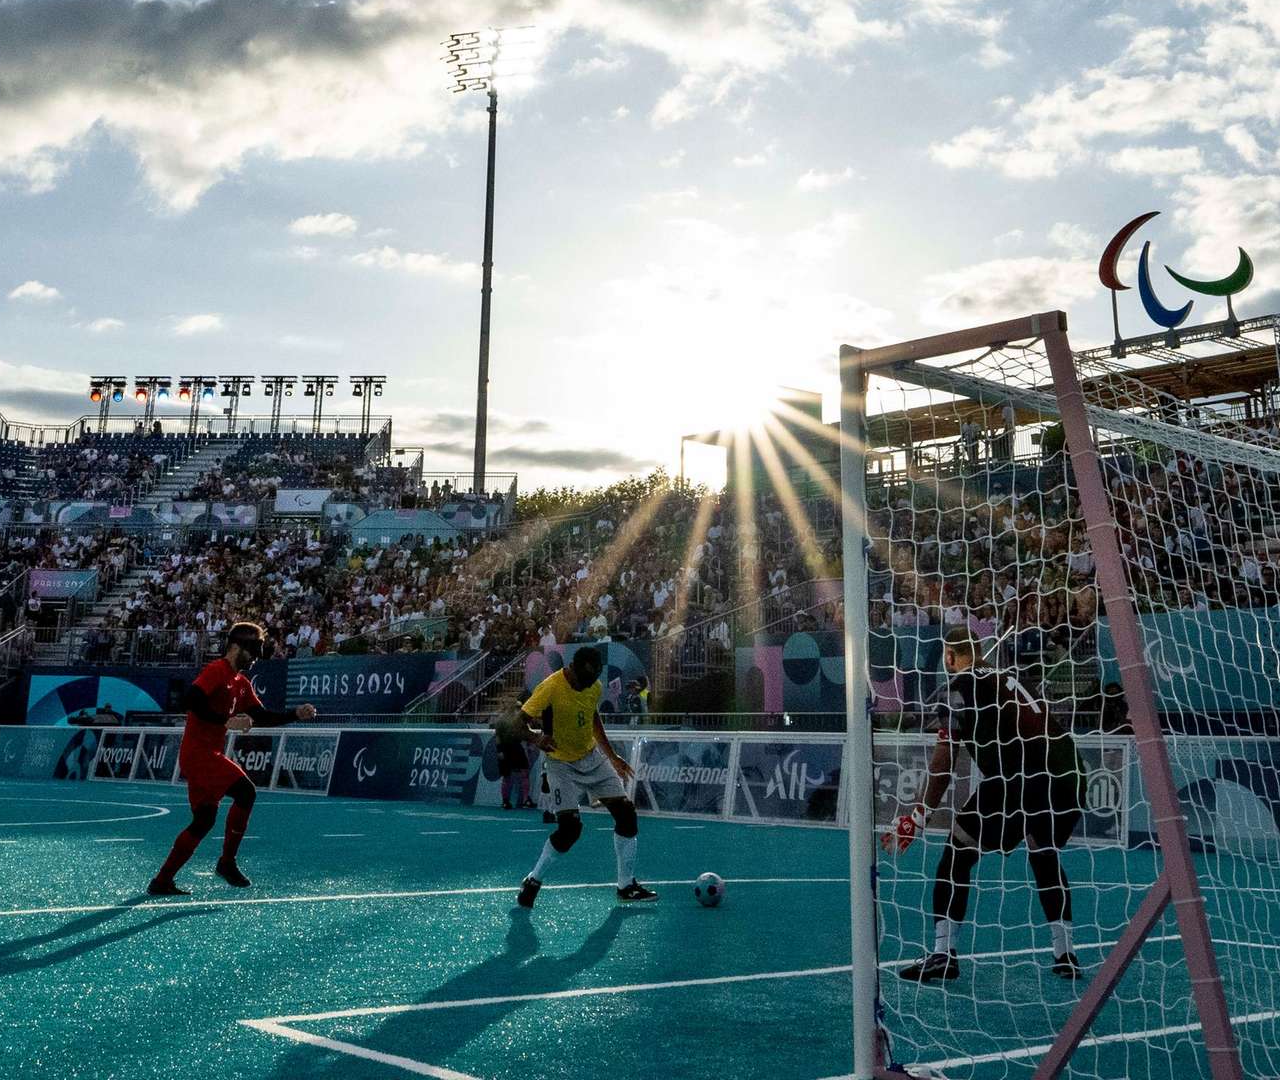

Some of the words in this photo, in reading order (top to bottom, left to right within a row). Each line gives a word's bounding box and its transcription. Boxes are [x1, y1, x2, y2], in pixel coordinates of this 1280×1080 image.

[299, 673, 349, 696] PARIS
[356, 672, 405, 696] 2024
[1005, 676, 1042, 713] 1
[576, 710, 585, 728] 8
[99, 746, 135, 764] TOYOTA
[279, 751, 318, 772] Allianz
[412, 747, 454, 766] PARIS
[409, 768, 449, 788] 2024
[554, 788, 562, 805] 8
